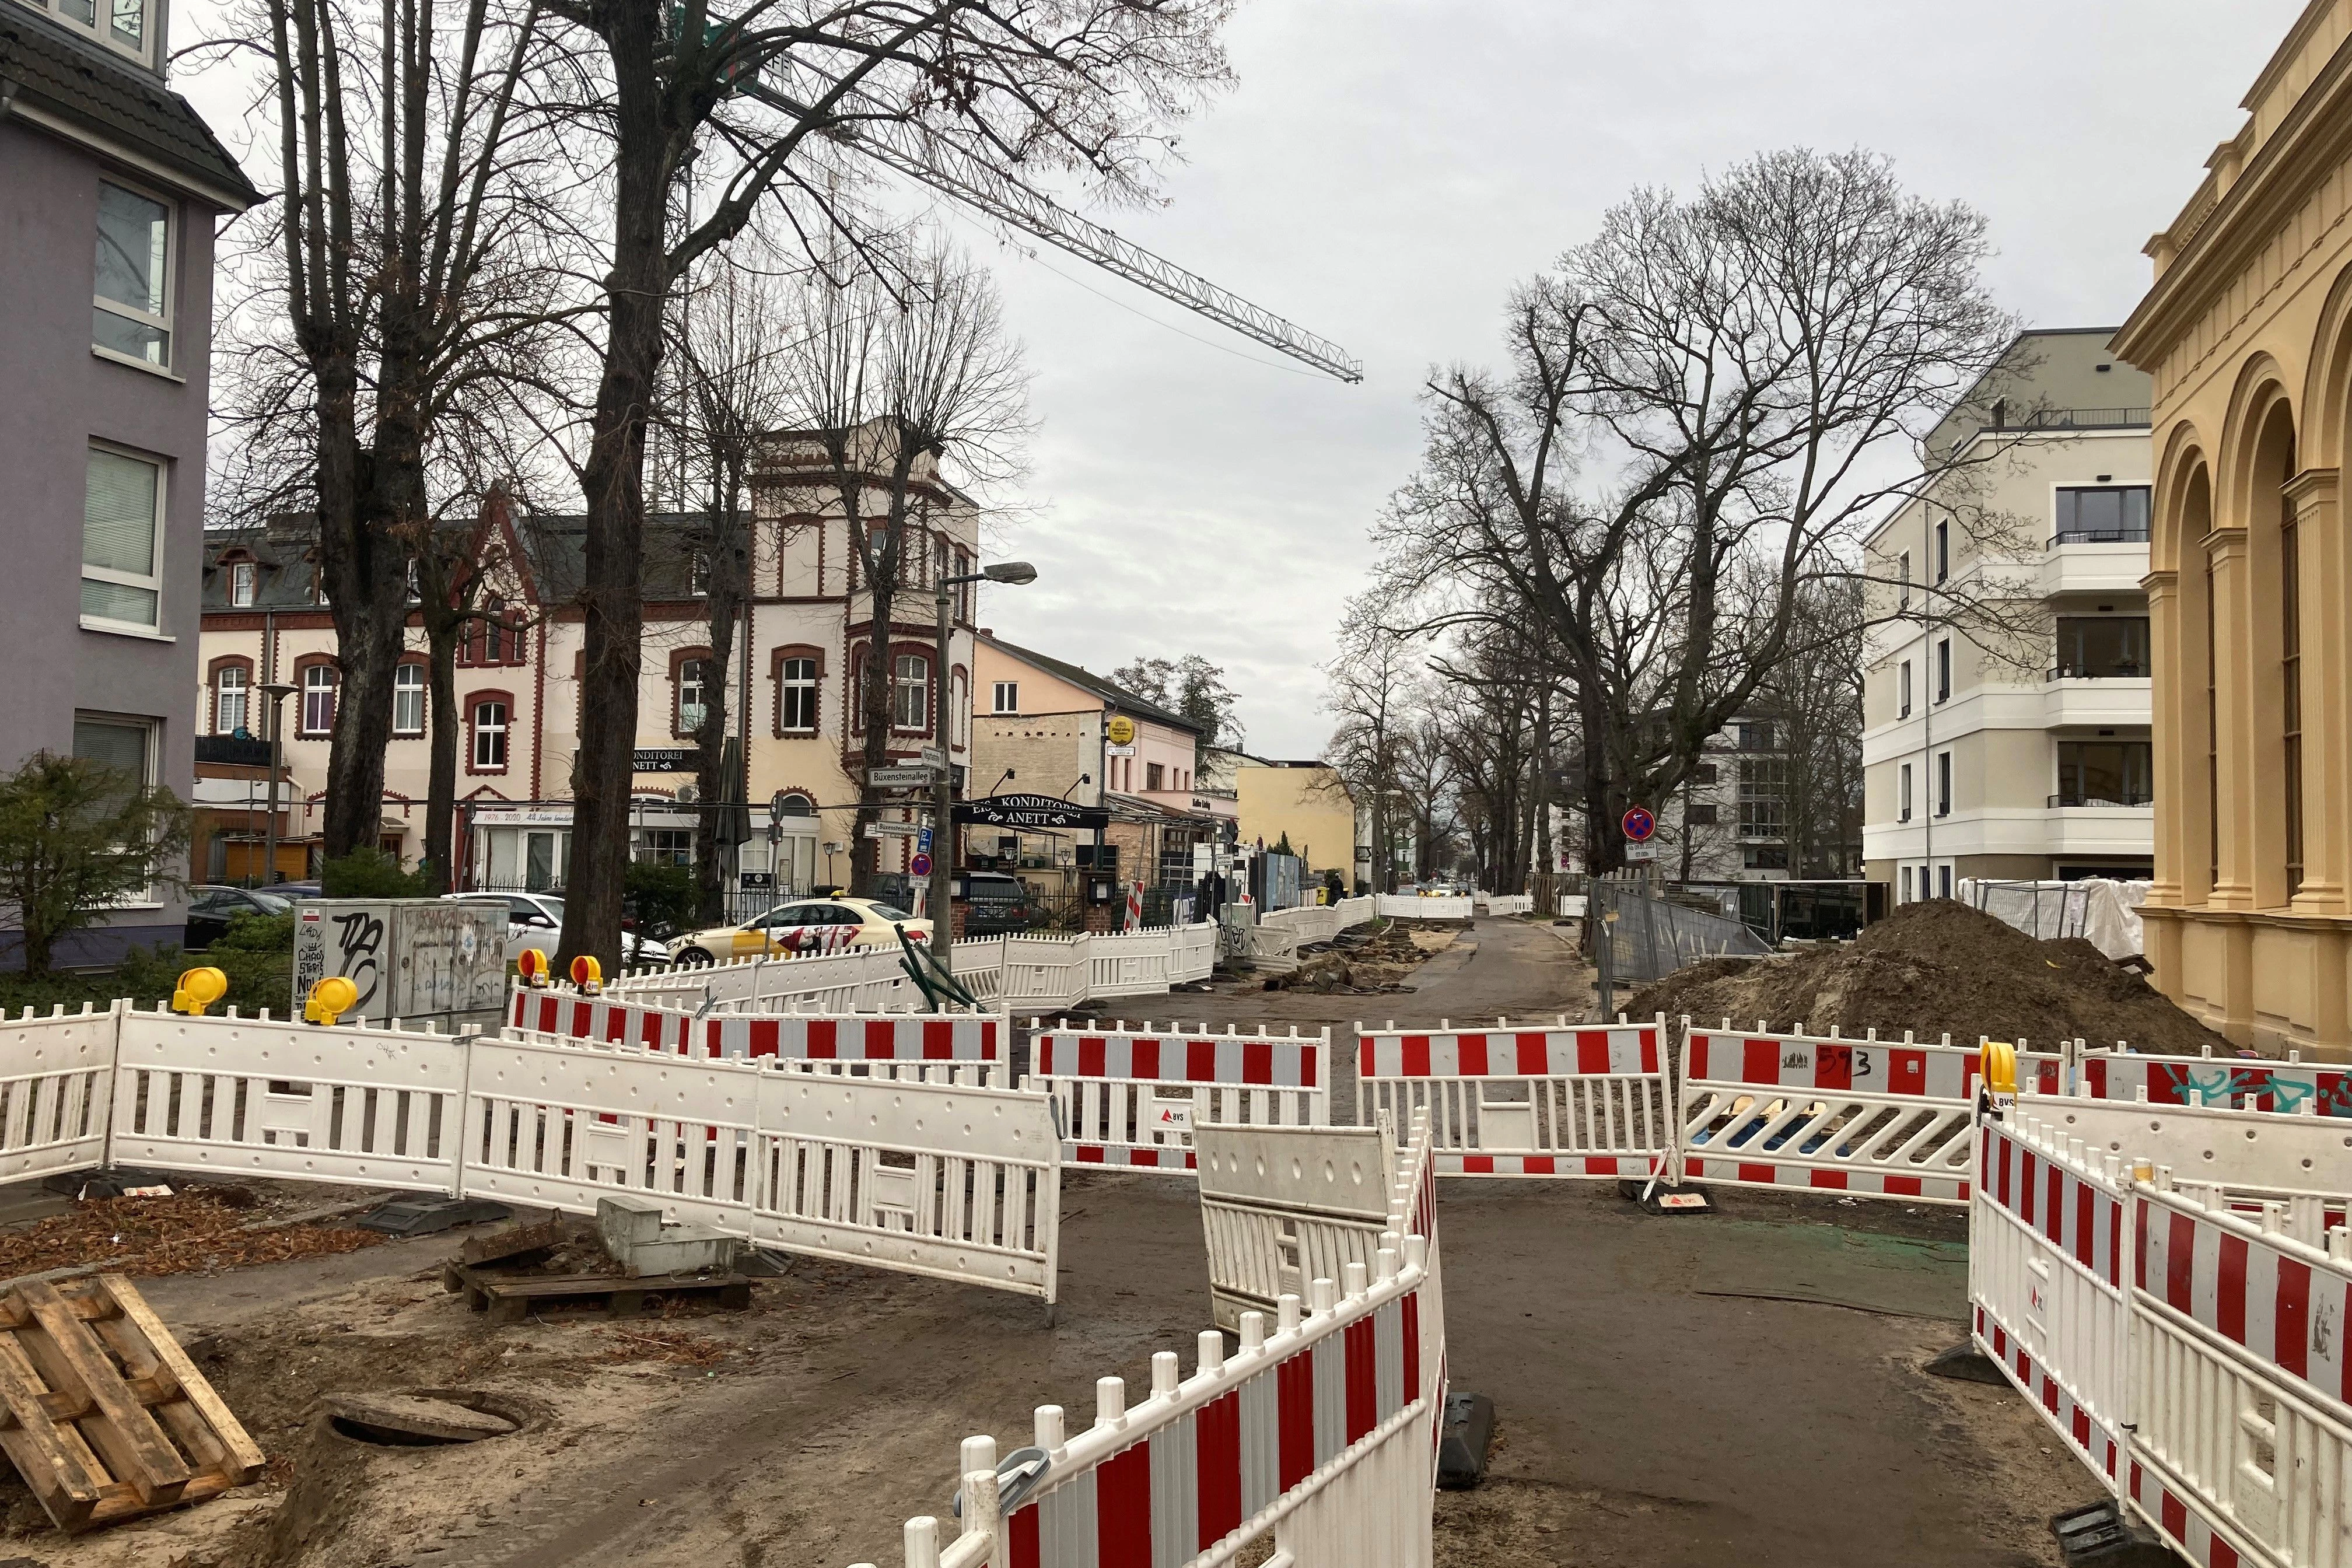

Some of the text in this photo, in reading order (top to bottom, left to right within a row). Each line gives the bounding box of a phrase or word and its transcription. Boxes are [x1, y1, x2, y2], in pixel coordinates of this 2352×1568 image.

[633, 761, 658, 770] NETT
[874, 771, 928, 782] Büxensteinallee
[484, 813, 499, 821] 1976
[505, 813, 521, 821] 2020
[1006, 812, 1049, 824] ANETT
[879, 823, 916, 833] Büxensteinallee
[299, 948, 324, 963] CHAOS
[299, 961, 324, 975] STARTS
[1999, 1098, 2014, 1107] BVS
[1172, 1113, 1184, 1121] BVS
